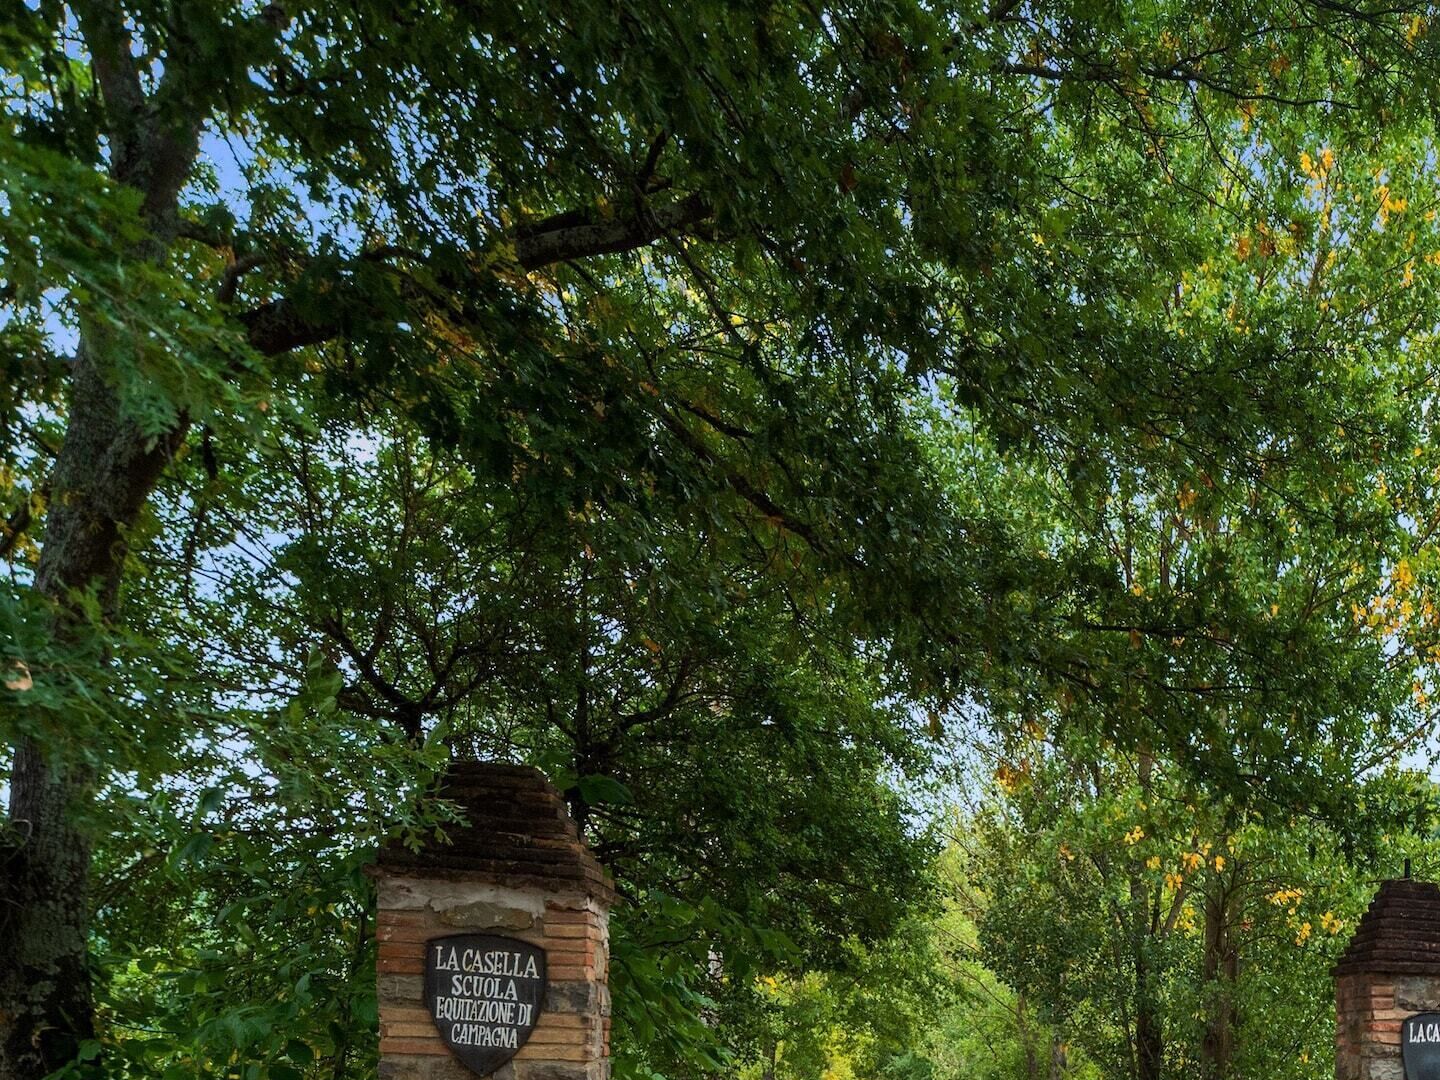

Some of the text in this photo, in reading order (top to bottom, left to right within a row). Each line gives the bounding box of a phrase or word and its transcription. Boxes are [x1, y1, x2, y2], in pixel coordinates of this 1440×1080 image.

[435, 946, 540, 979] LA CASELLA
[451, 974, 518, 1001] SCUOLA
[436, 996, 533, 1026] EQUITAZIONE DI
[451, 1023, 518, 1049] CAMPAGNA
[1409, 1022, 1426, 1043] LA
